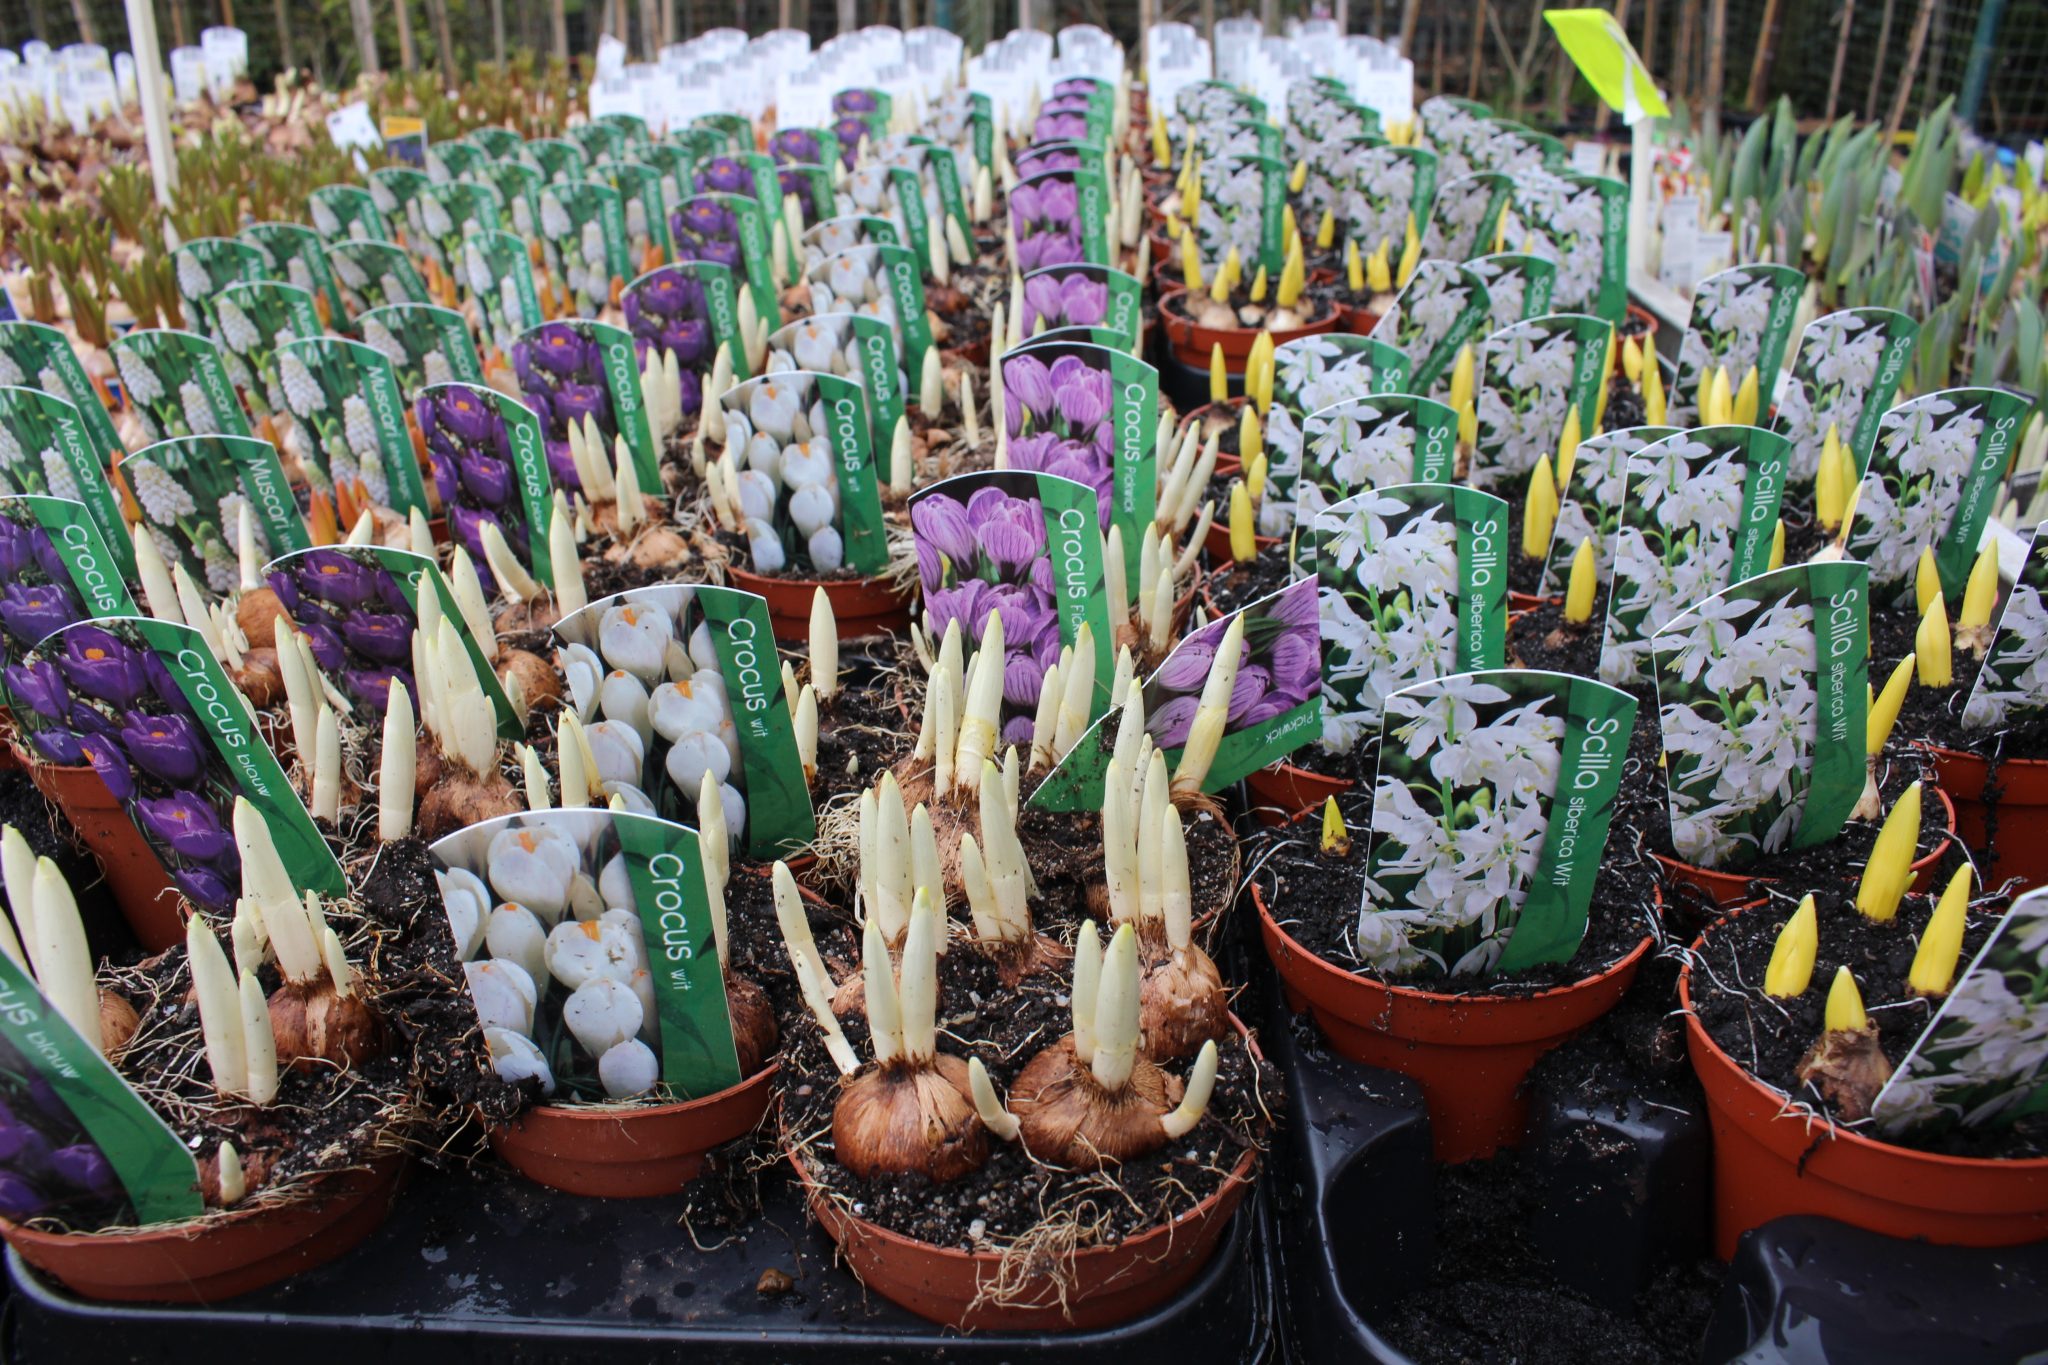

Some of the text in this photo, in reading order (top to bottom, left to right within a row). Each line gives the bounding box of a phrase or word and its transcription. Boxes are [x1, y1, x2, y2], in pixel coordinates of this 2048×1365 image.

[711, 277, 733, 338] Crocus
[895, 262, 918, 322] Crocus
[1529, 276, 1549, 317] Scilla
[1773, 285, 1797, 329] Scilla
[1448, 306, 1482, 345] Scilla
[51, 341, 94, 402] Muscari
[197, 352, 237, 421] Muscari
[610, 344, 636, 412] Crocus
[867, 335, 890, 401] Crocus
[1580, 338, 1602, 383] Scilla
[1880, 336, 1911, 385] Scilla
[367, 365, 402, 440] Muscari
[835, 399, 861, 472] Crocus
[1124, 384, 1145, 461] Crocus
[57, 417, 104, 494] Muscari
[516, 423, 541, 497] Crocus
[1422, 426, 1448, 483] Scilla
[1980, 416, 2016, 472] Scilla
[248, 458, 294, 530] Muscari
[1751, 461, 1781, 523] Scilla
[1963, 475, 1986, 522] siberica
[63, 524, 117, 612] Crocus
[1060, 509, 1087, 599] Crocus
[1471, 520, 1497, 587] Scilla
[1470, 594, 1485, 652] siberica
[727, 618, 769, 738] Crocus wit
[1830, 589, 1858, 742] Scilla siberica Wit
[178, 650, 271, 797] Crocus blauw
[1265, 709, 1314, 744] Pickwick
[1552, 718, 1619, 886] Scilla siberica Wit
[649, 853, 692, 990] Crocus wit
[26, 1031, 81, 1078] blauw
